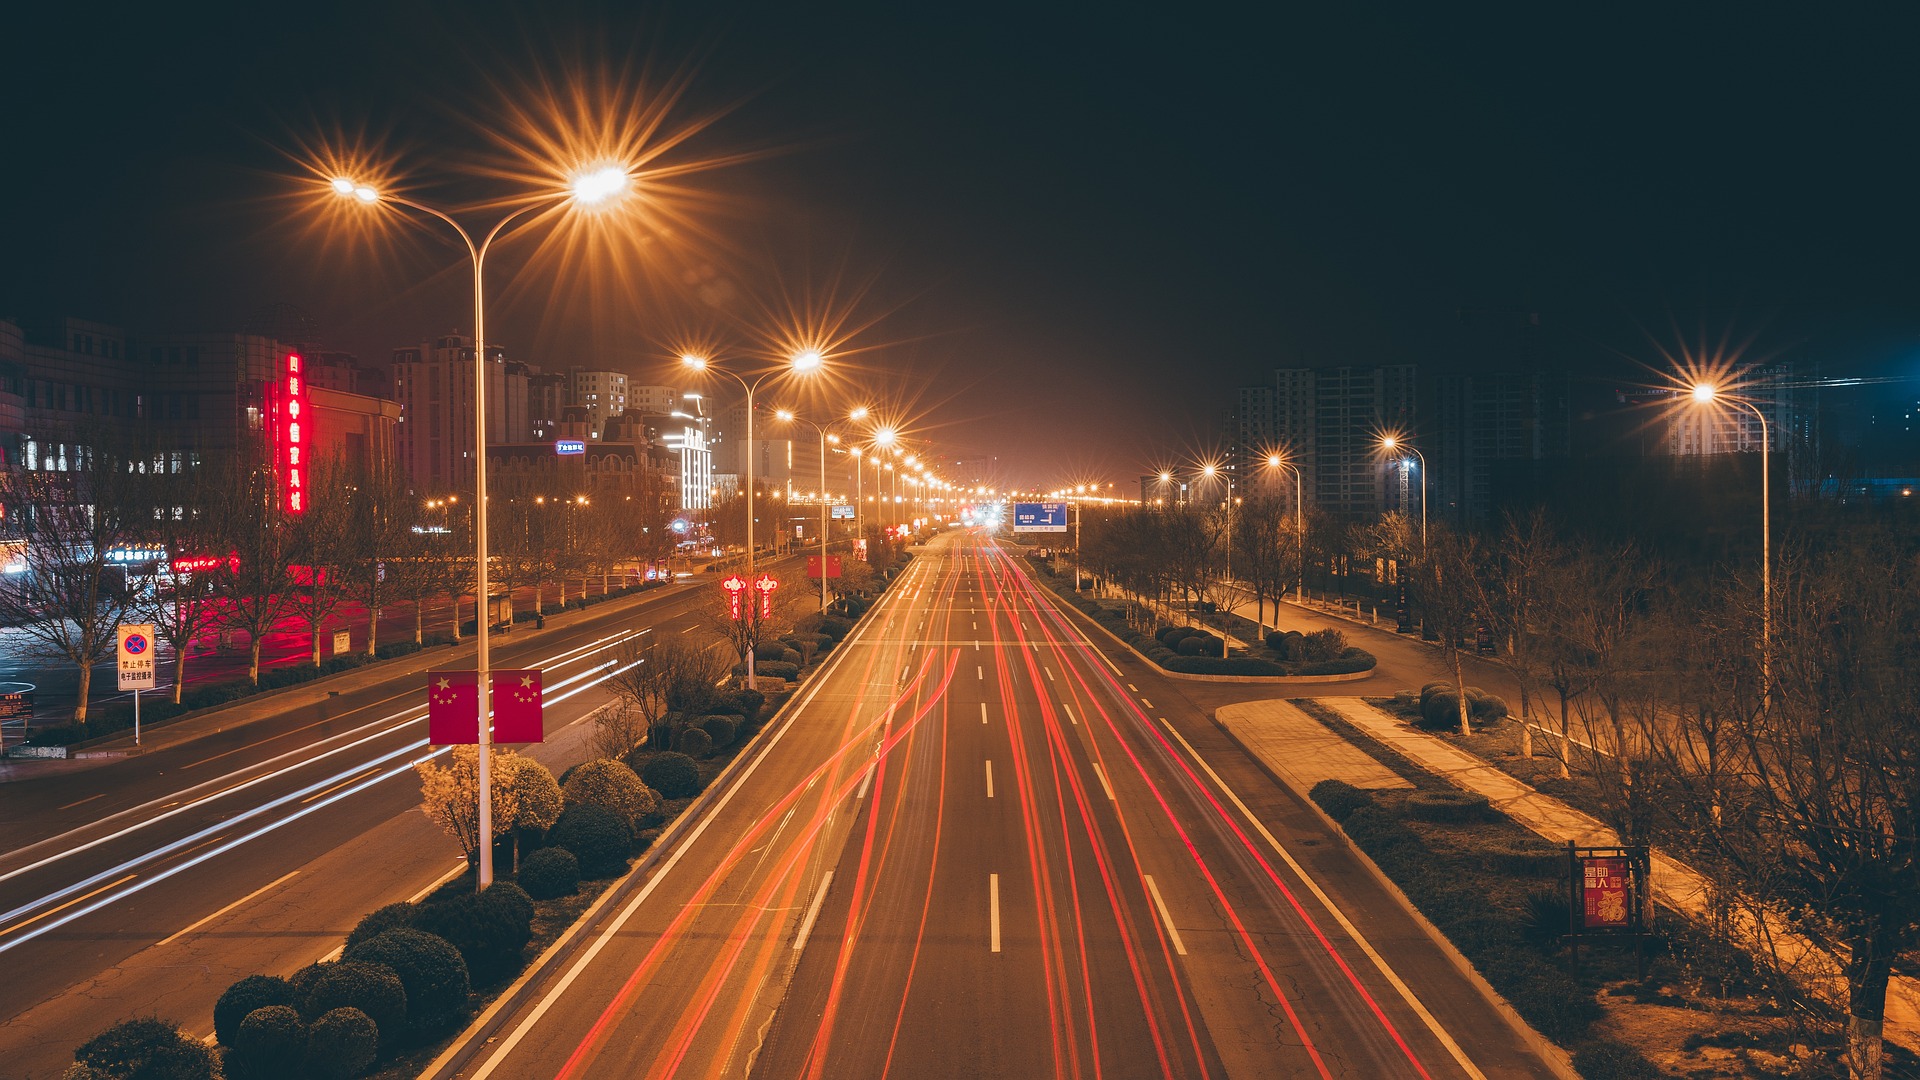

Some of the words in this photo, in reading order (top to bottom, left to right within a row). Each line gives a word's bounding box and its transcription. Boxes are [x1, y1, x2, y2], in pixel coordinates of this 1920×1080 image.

[122, 660, 151, 669] 禁止停车
[121, 671, 152, 681] 电子监控摄录
